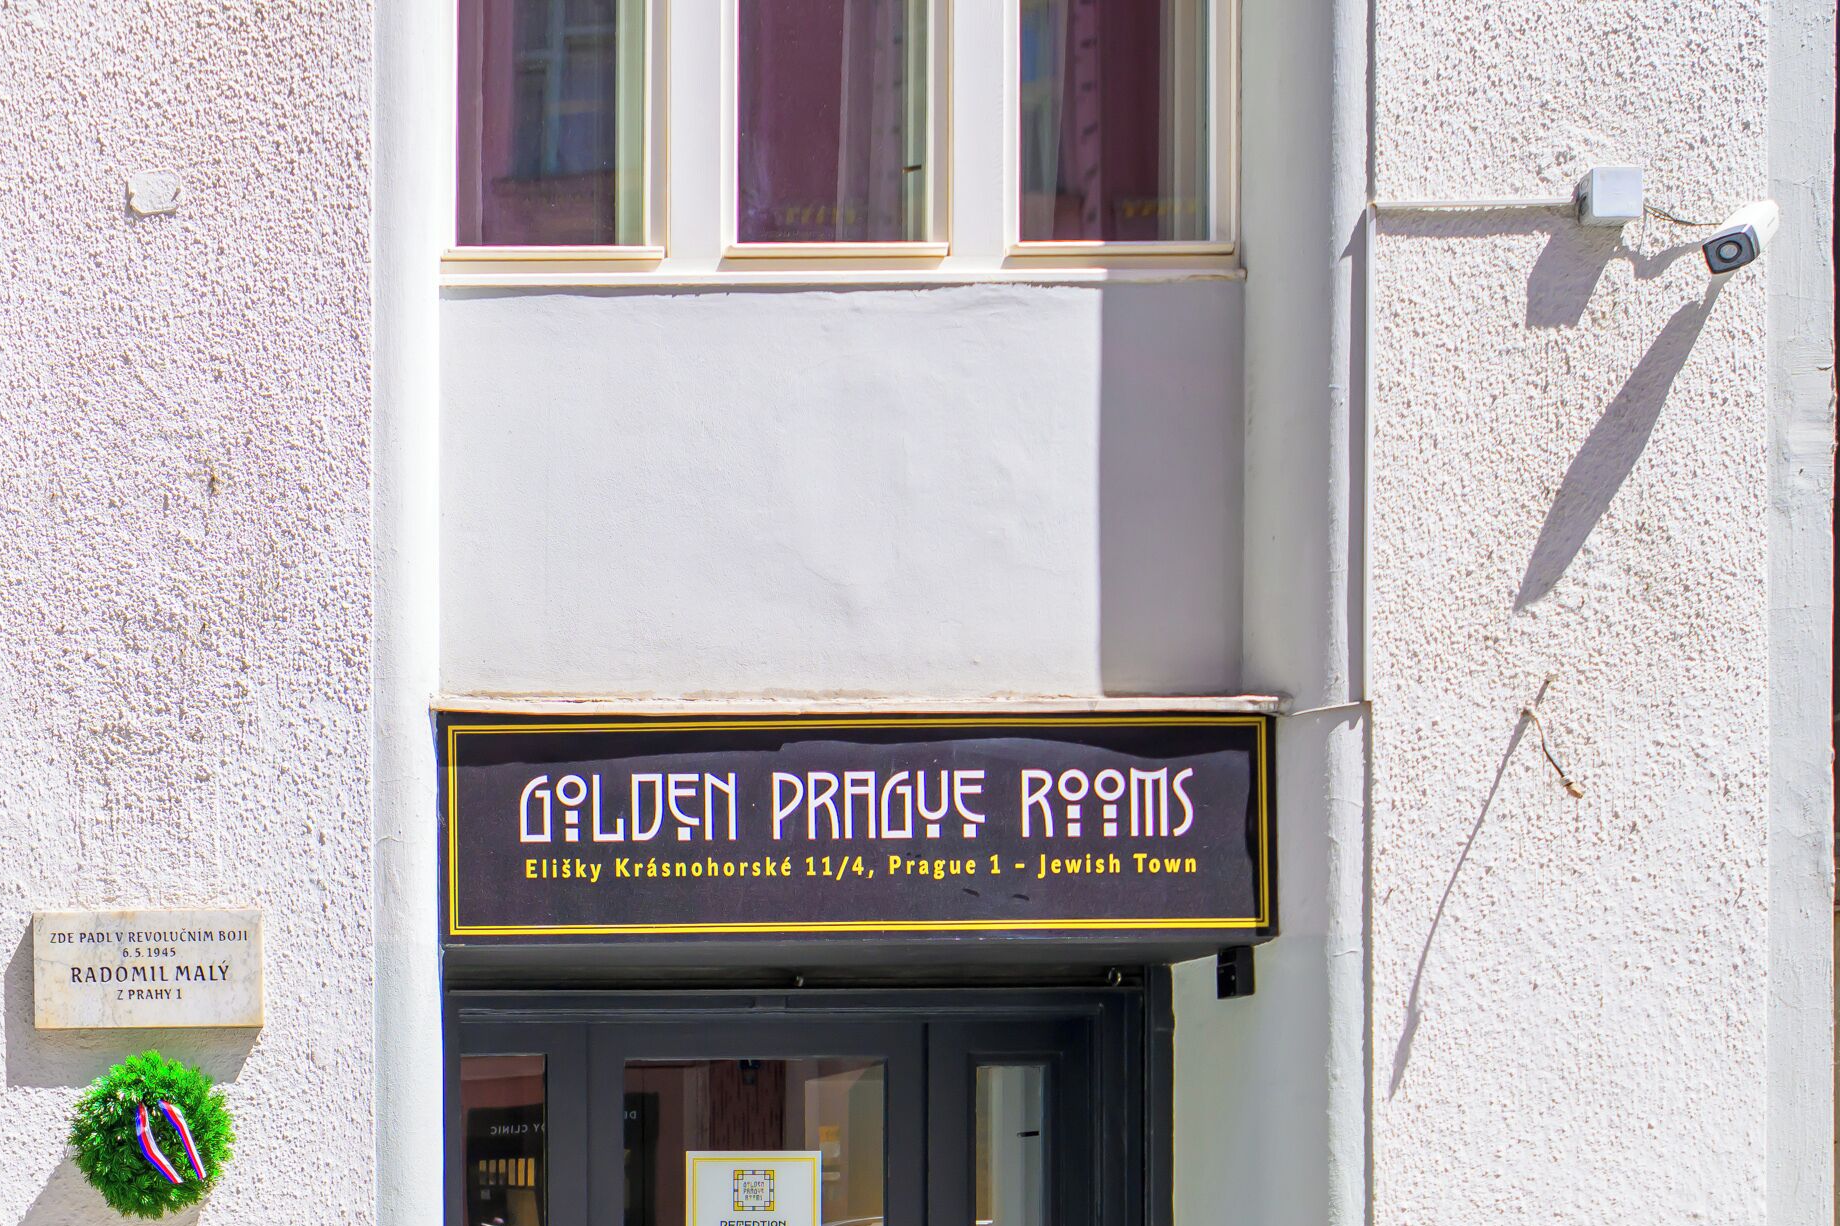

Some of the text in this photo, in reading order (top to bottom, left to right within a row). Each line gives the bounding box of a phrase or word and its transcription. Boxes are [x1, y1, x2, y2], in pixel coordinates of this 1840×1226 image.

[519, 767, 1195, 843] GOLDEN PRAGUE ROOMS
[525, 858, 602, 883] Elišky
[615, 856, 792, 878] Krásnohorské
[805, 855, 875, 881] 11/4,
[888, 854, 977, 880] Prague
[989, 854, 1001, 875] 1
[1037, 852, 1122, 880] Jewish
[1132, 852, 1198, 874] Town
[50, 928, 248, 944] ZDE PADL V REVOLUČNÍM BOJI
[70, 960, 230, 983] RADOMIL MALÝ
[117, 988, 182, 1000] Z PRAHY 1
